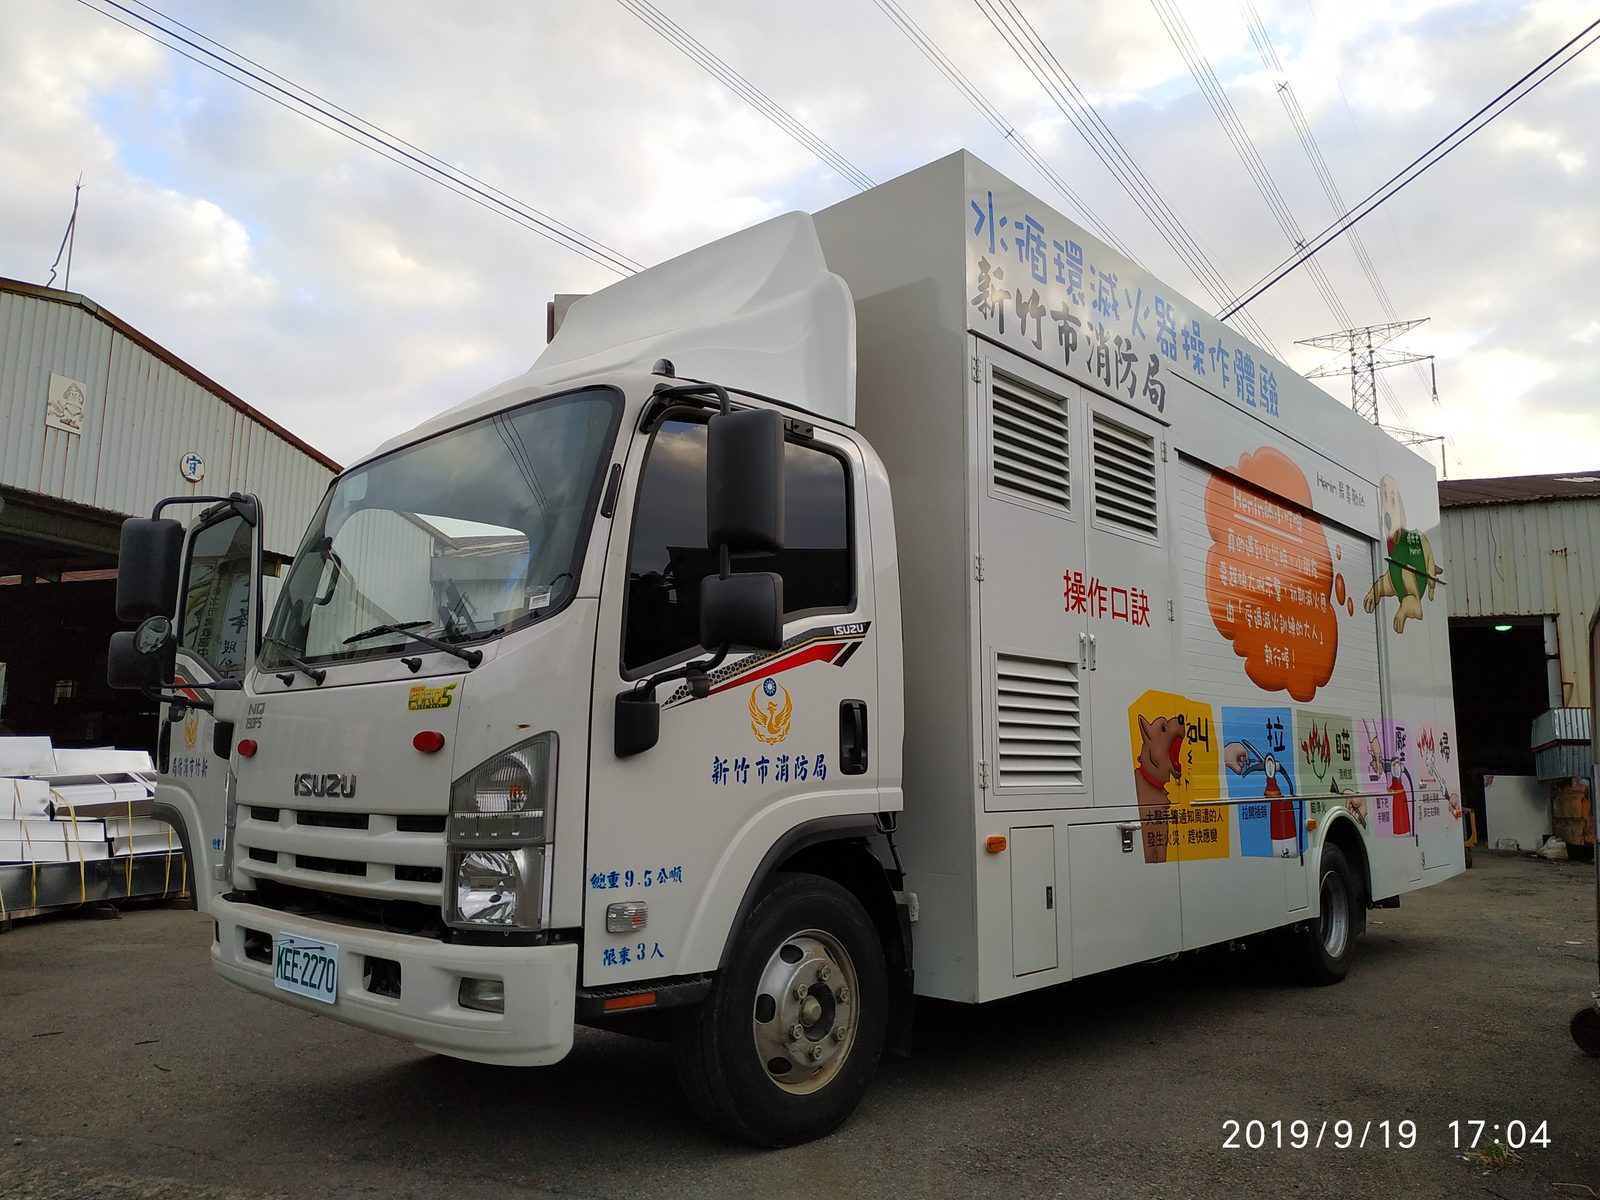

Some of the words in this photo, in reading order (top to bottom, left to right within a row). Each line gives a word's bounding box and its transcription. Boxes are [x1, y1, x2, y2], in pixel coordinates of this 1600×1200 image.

[971, 190, 1280, 418] 水循環滅火器操作體驗
[971, 256, 1166, 413] 新竹市消防局
[1063, 569, 1150, 628] 操作口訣
[833, 624, 864, 636] ISUZU
[1187, 717, 1209, 752] 叫
[1266, 715, 1285, 752] 拉
[1336, 728, 1350, 761] 瞄
[294, 773, 357, 798] ISUZU
[711, 753, 828, 786] 新竹市消防局
[276, 945, 336, 993] KEE-2270
